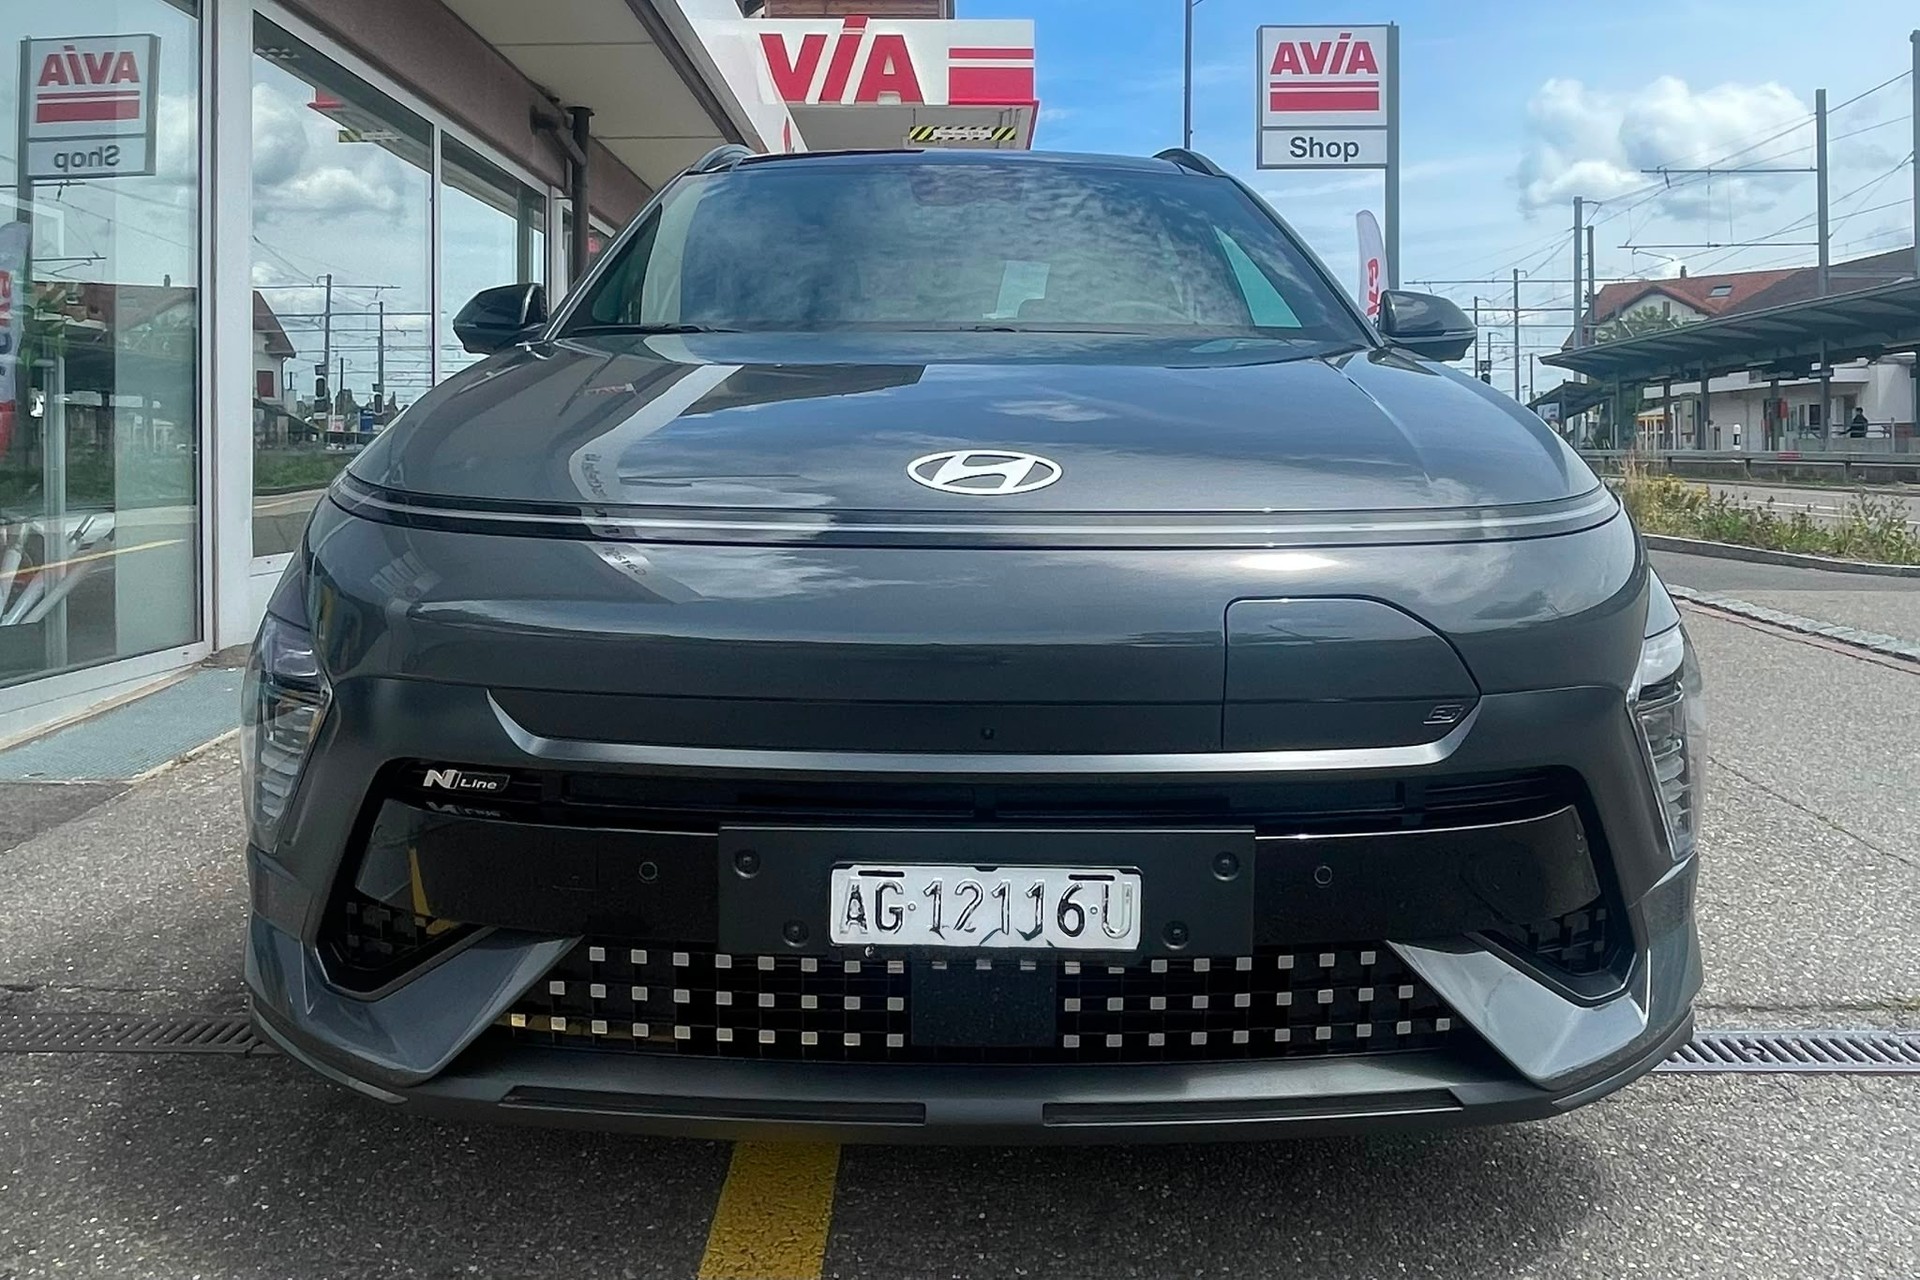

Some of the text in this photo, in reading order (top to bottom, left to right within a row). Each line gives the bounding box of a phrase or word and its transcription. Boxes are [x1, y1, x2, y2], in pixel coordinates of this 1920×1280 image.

[1269, 32, 1379, 75] AVIA
[1289, 136, 1360, 163] Shop
[460, 778, 498, 790] Line
